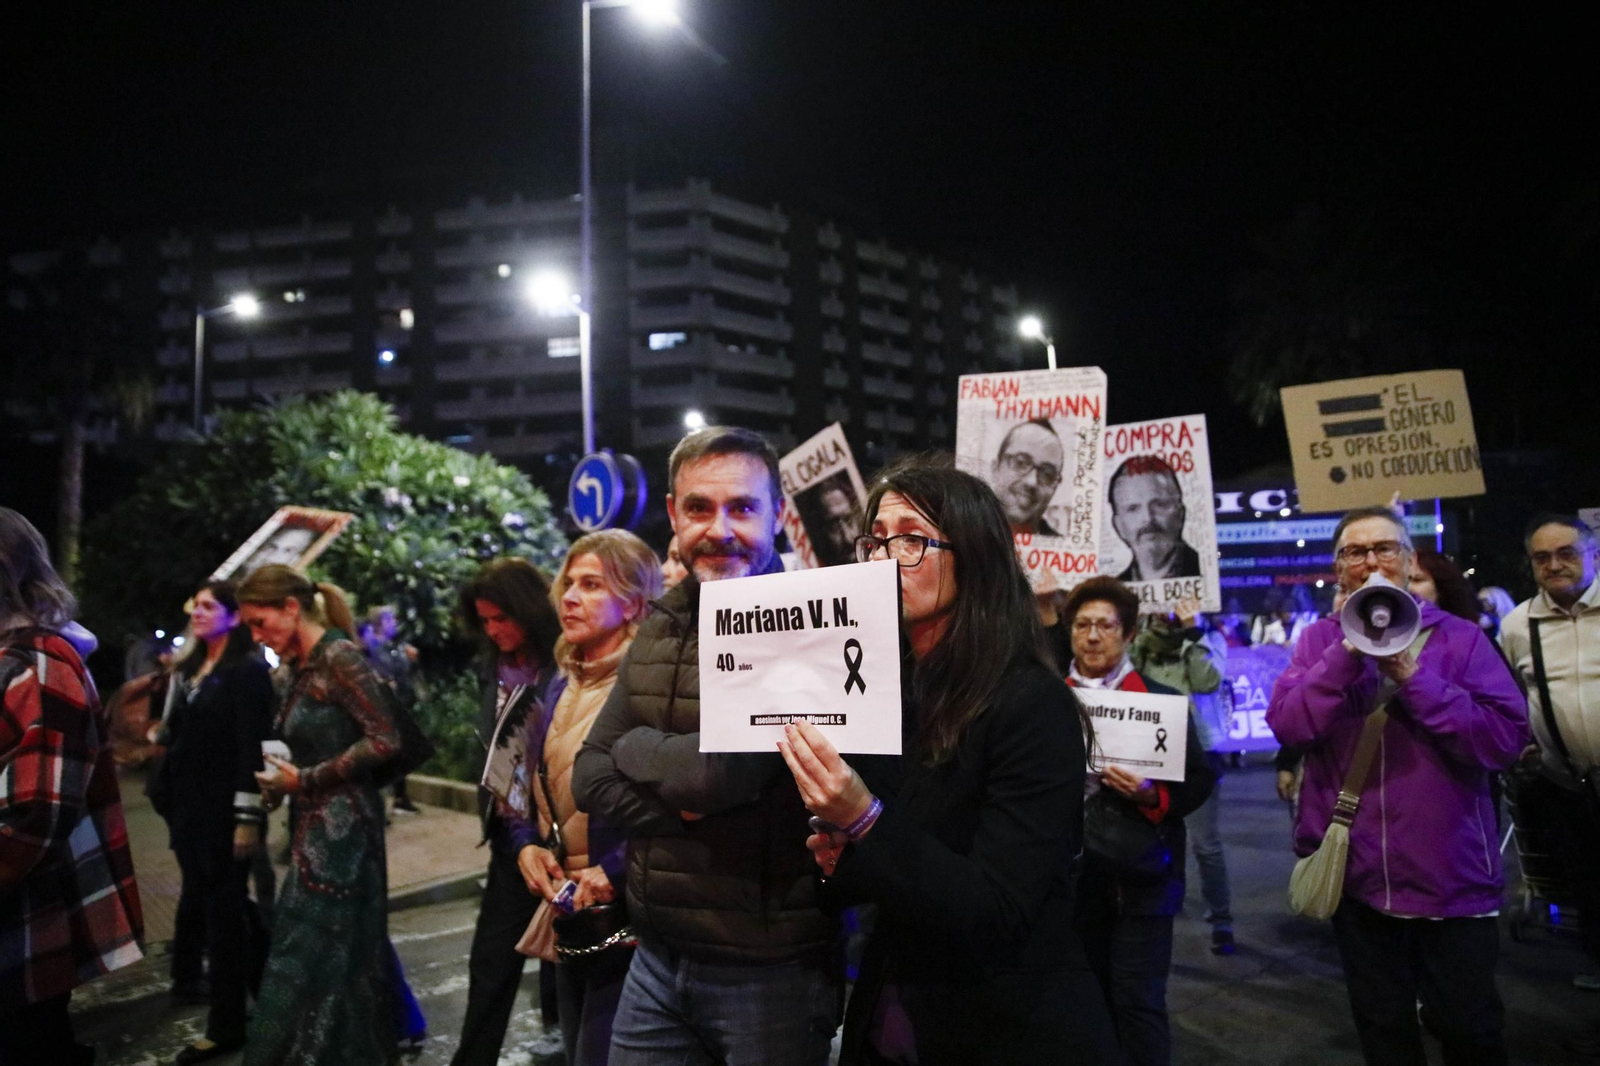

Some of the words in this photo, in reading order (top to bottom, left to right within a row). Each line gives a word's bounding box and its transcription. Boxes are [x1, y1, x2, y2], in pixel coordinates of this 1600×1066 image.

[960, 377, 1021, 400] FABIAN
[1394, 383, 1433, 403] EL
[994, 395, 1100, 420] THYLMANN
[1310, 441, 1333, 460] ES
[1352, 460, 1374, 481] NO
[1018, 548, 1098, 573] OTADOR
[715, 605, 805, 636] Mariana
[807, 599, 829, 629] V.
[833, 597, 859, 629] N.,
[716, 653, 735, 672] 40
[738, 662, 753, 671] años
[1086, 704, 1126, 721] udrey
